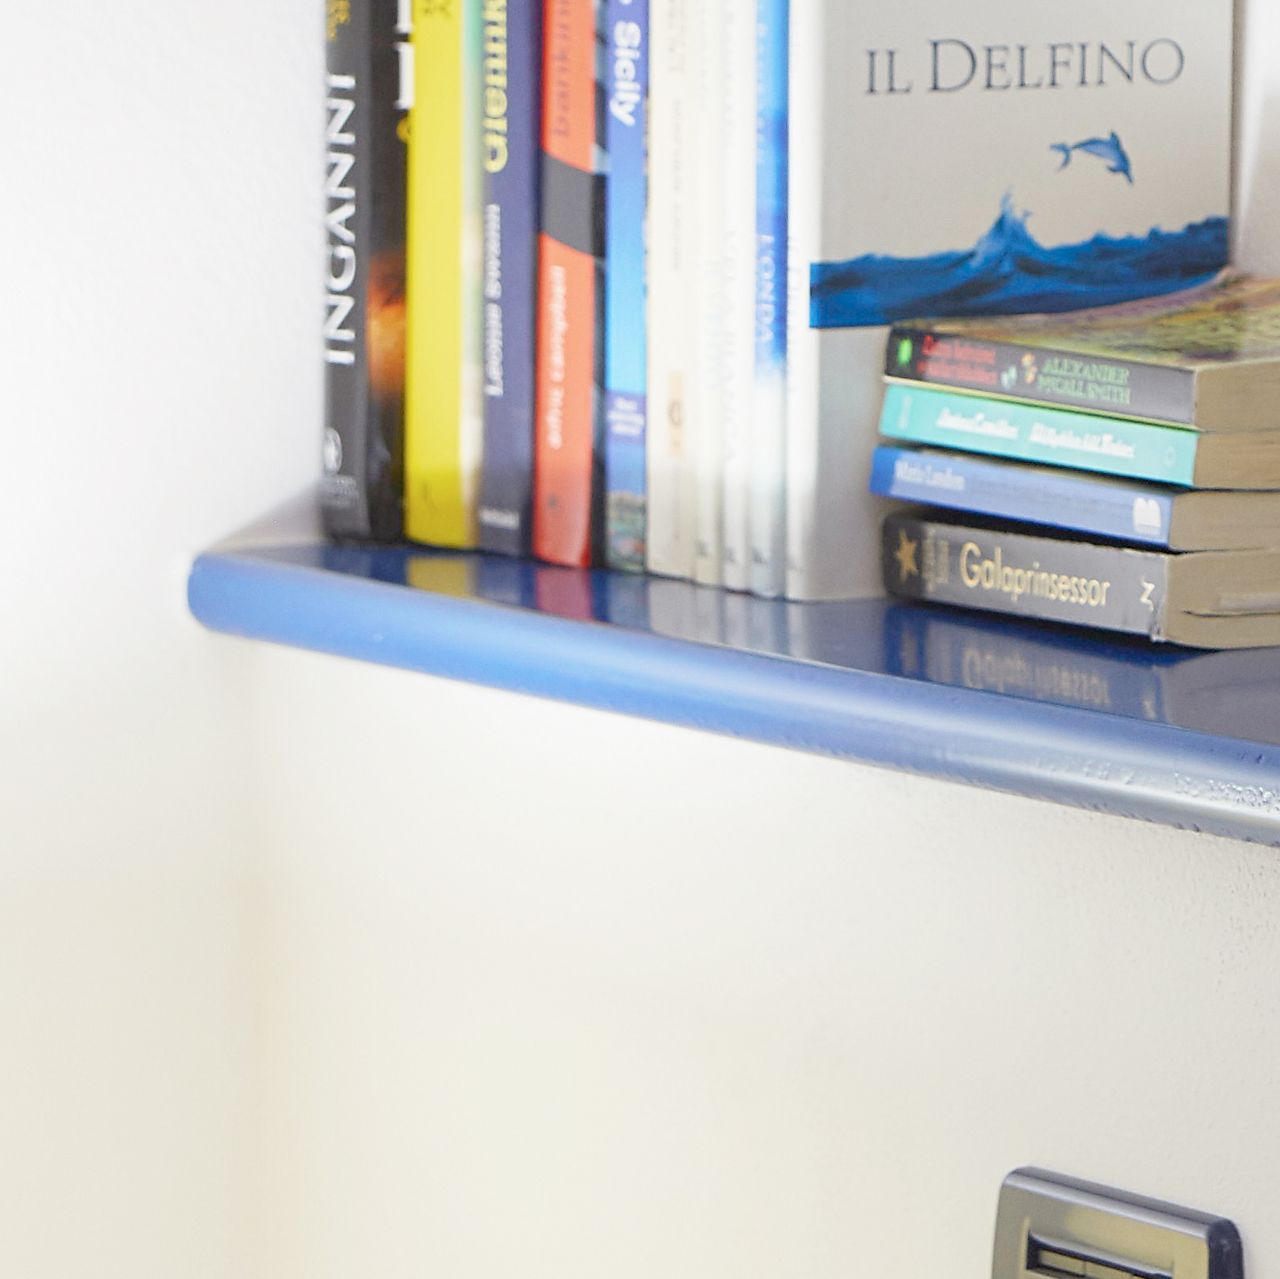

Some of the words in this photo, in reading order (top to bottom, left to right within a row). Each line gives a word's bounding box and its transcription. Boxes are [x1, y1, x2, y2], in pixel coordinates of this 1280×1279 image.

[609, 21, 641, 126] Sicily
[865, 48, 913, 95] IL
[928, 37, 1185, 93] DELFINO
[325, 74, 356, 365] INGANNI
[960, 541, 1110, 607] Galaprinsessor
